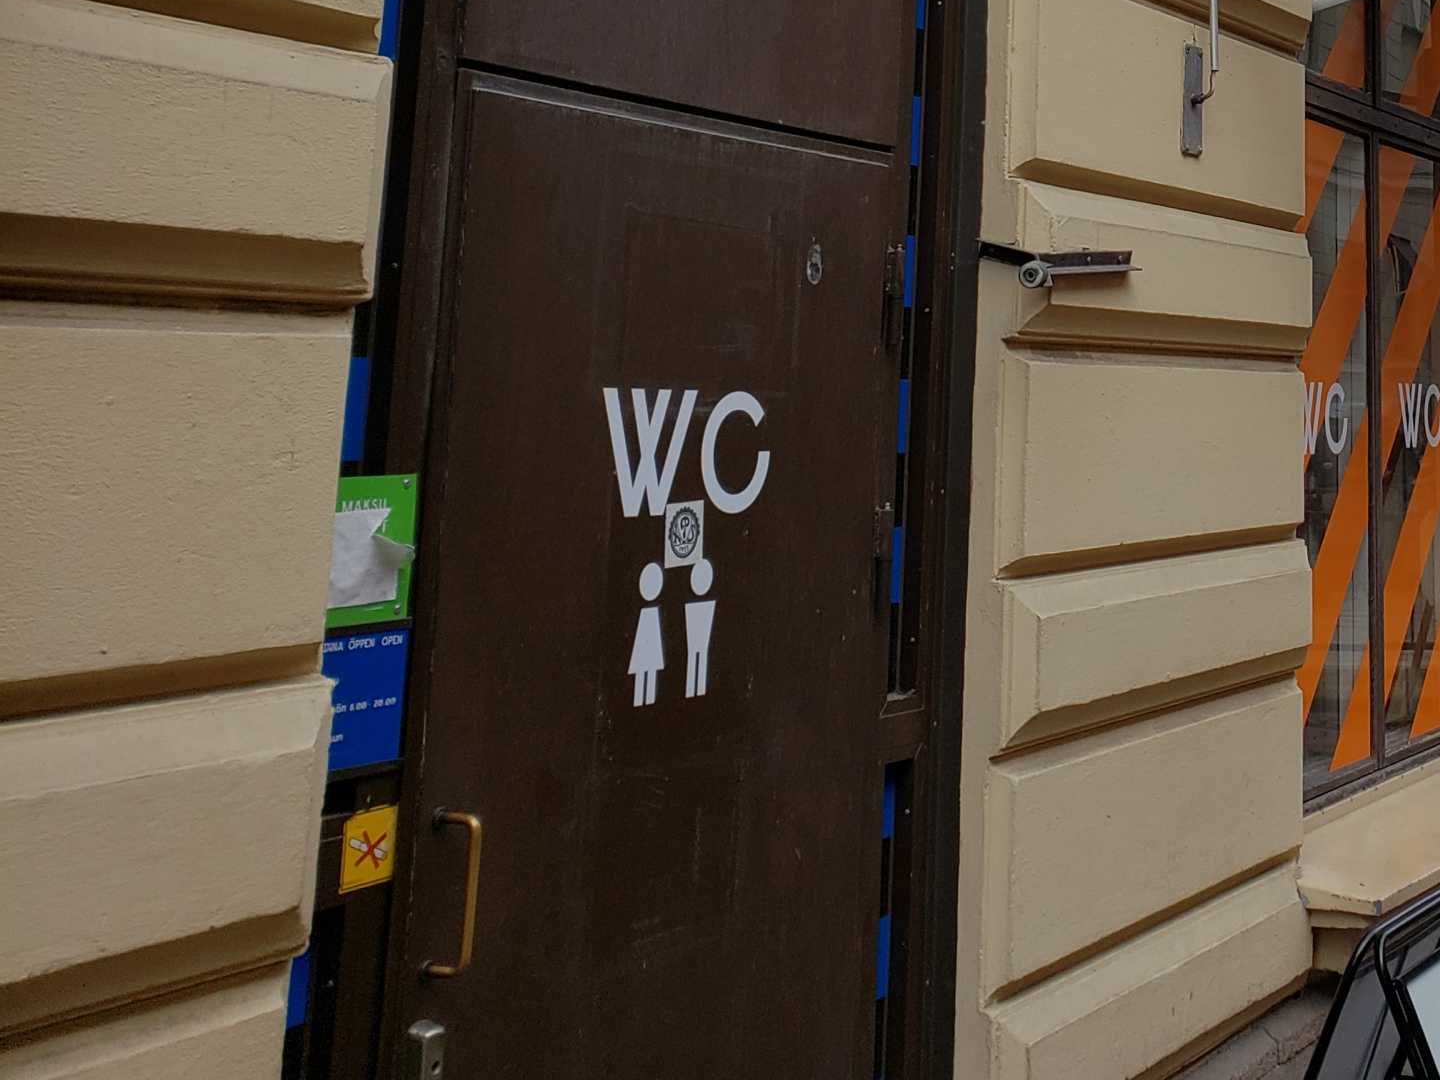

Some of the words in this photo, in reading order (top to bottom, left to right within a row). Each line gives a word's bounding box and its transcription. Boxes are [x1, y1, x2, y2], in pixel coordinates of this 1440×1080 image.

[603, 388, 770, 517] WC
[1305, 382, 1348, 455] WC
[381, 635, 404, 646] OPEN
